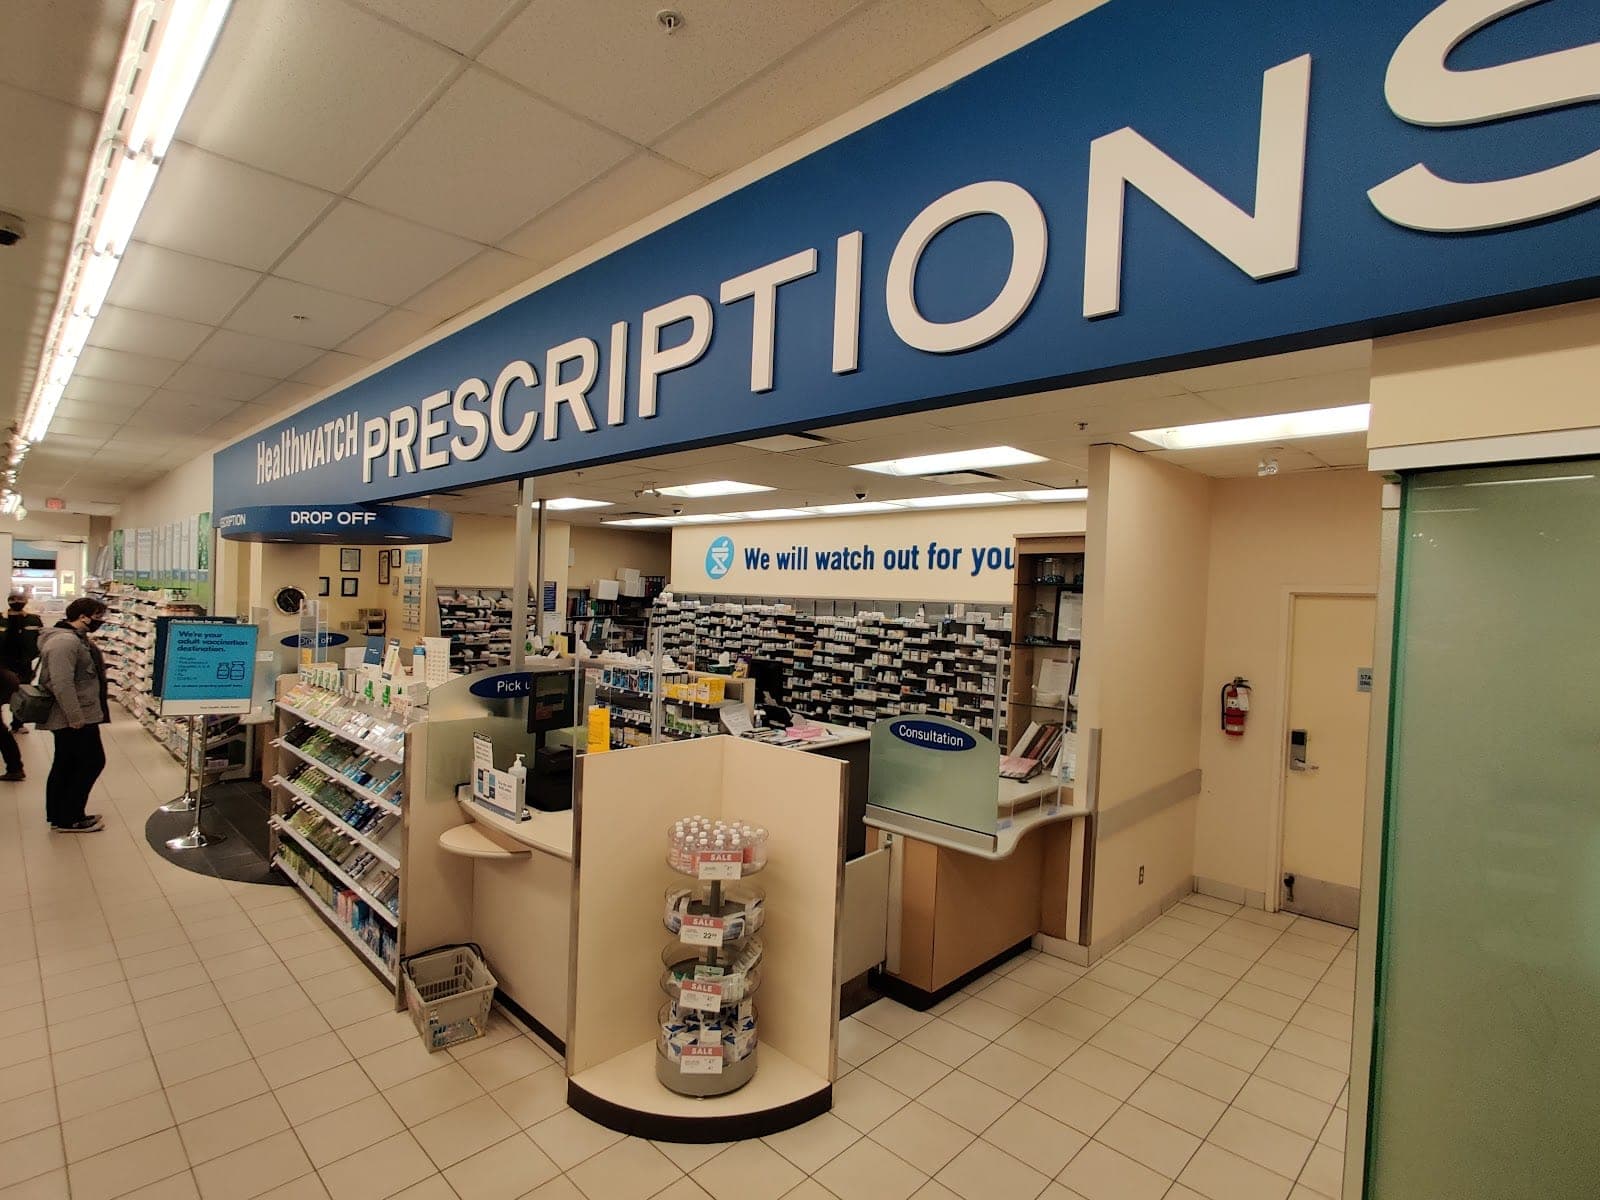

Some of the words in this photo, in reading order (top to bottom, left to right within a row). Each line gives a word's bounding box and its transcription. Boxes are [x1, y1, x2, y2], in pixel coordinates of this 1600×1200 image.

[361, 0, 1600, 484] PRESCRIPTIONS
[290, 511, 332, 525] DROP
[337, 512, 377, 525] OFF
[744, 547, 770, 570] We
[776, 545, 808, 571] will
[815, 544, 874, 571] watch
[883, 545, 919, 571] out
[927, 542, 963, 570] for
[971, 546, 1015, 577] you
[178, 630, 202, 638] We're
[497, 679, 521, 693] Pick
[898, 724, 964, 747] Consultation
[692, 917, 714, 927] SALE
[691, 983, 713, 992] SALE
